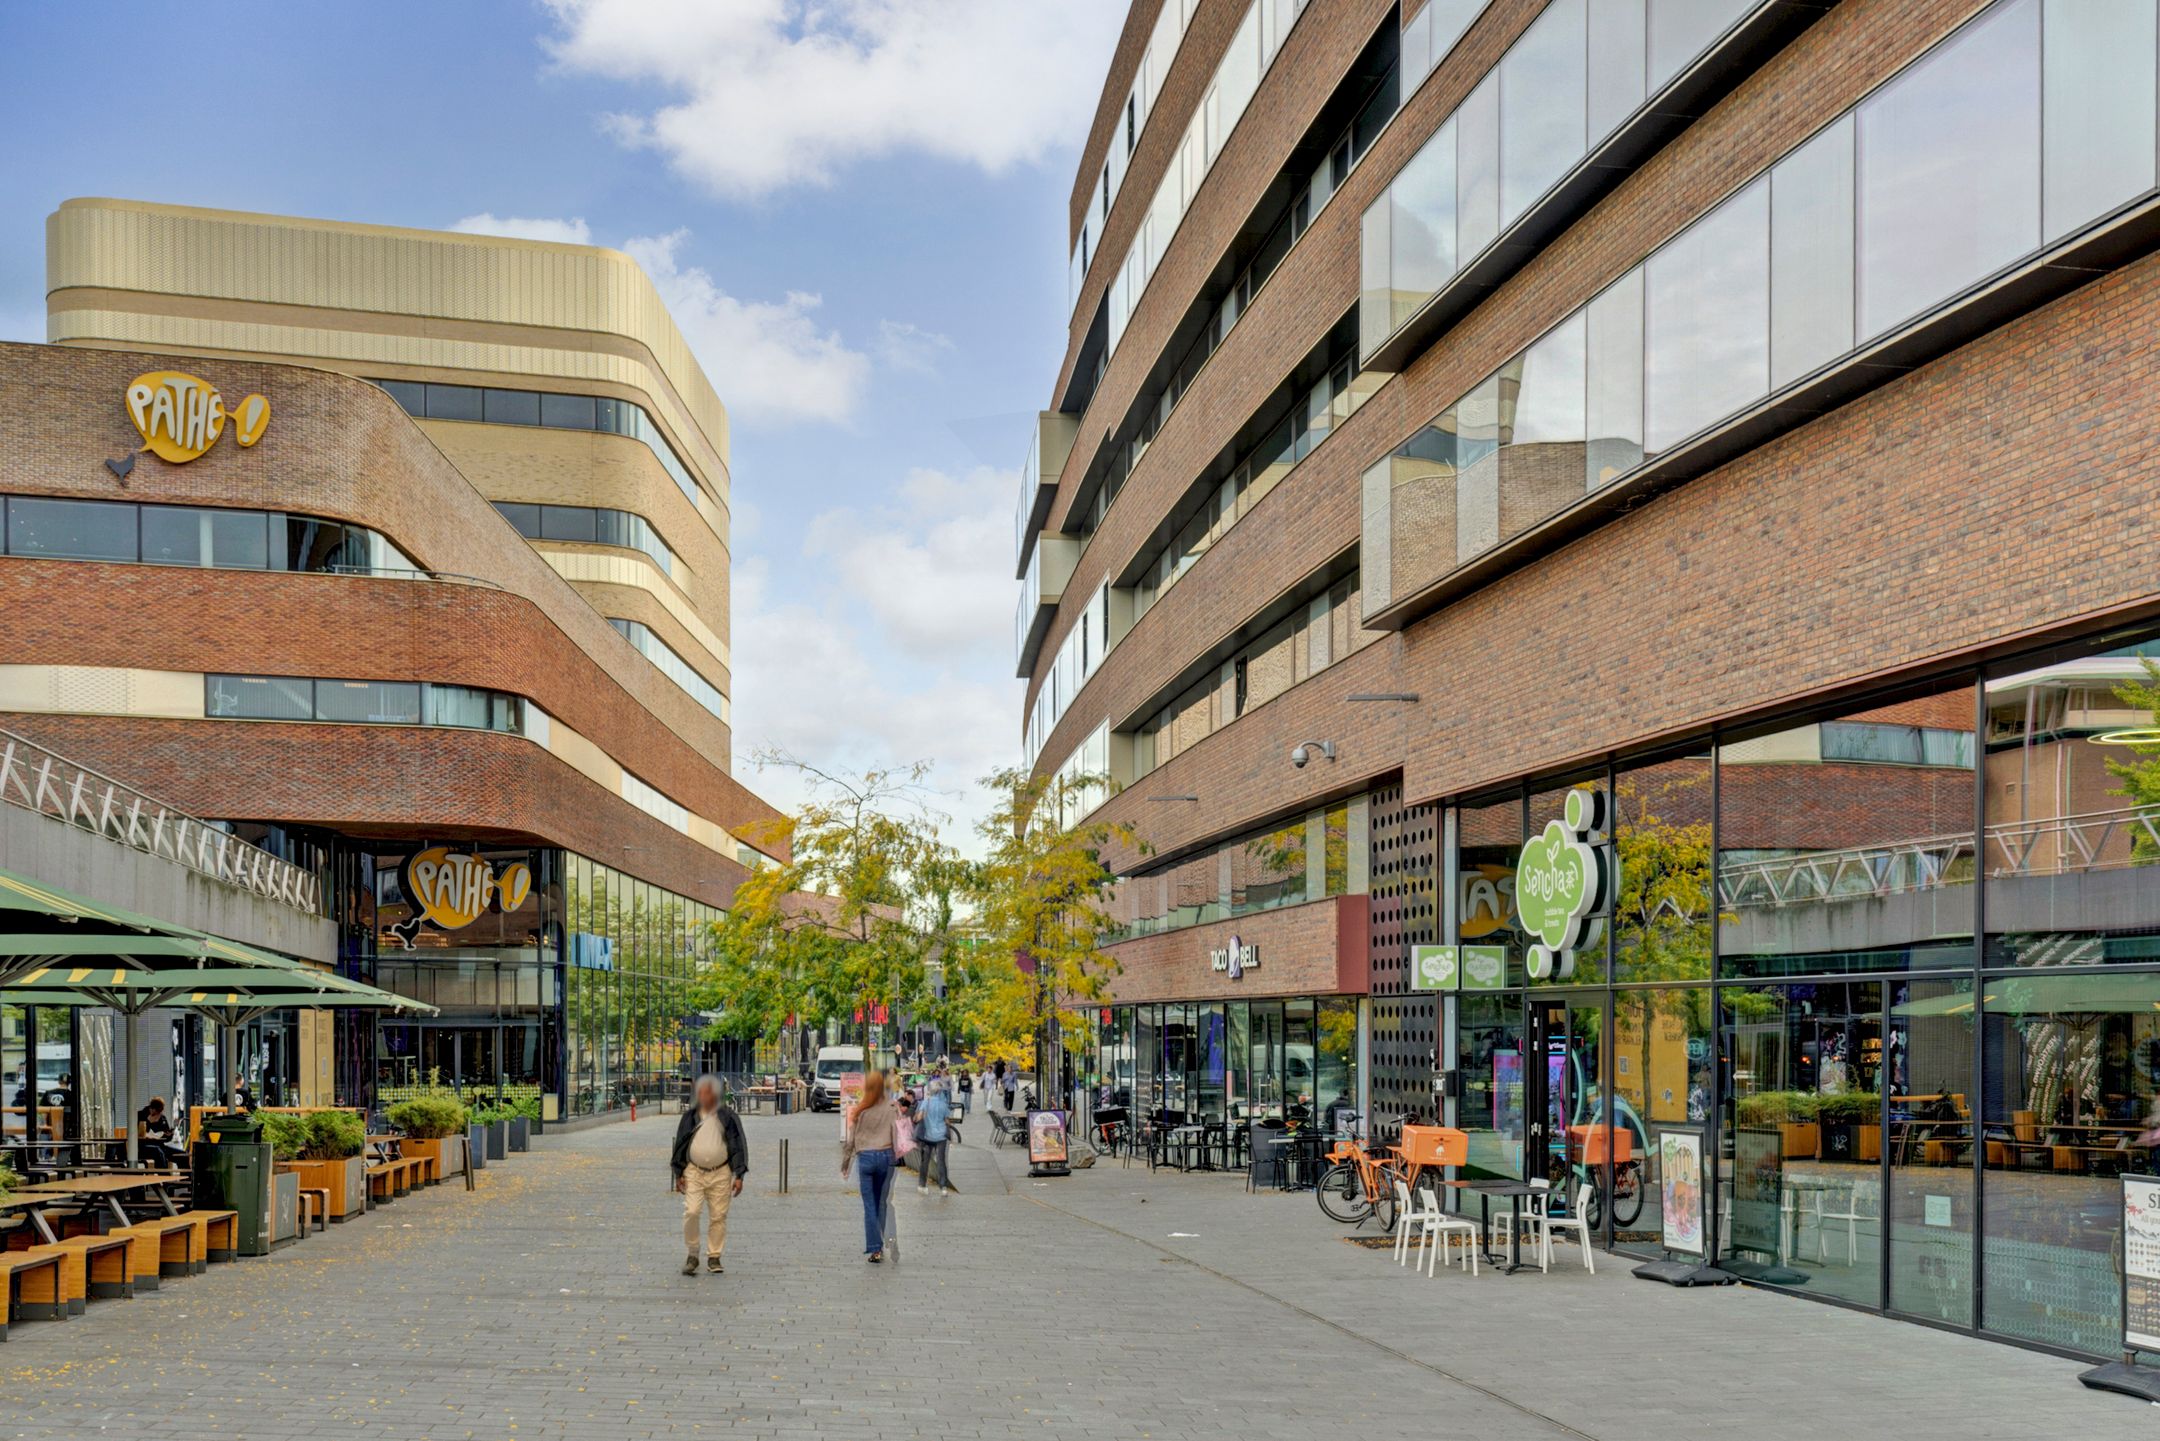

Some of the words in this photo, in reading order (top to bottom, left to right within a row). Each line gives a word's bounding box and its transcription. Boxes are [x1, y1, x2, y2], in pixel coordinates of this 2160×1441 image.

[1525, 862, 1572, 902] Sencha
[1211, 949, 1228, 970] TACO
[1240, 945, 1258, 968] BELL
